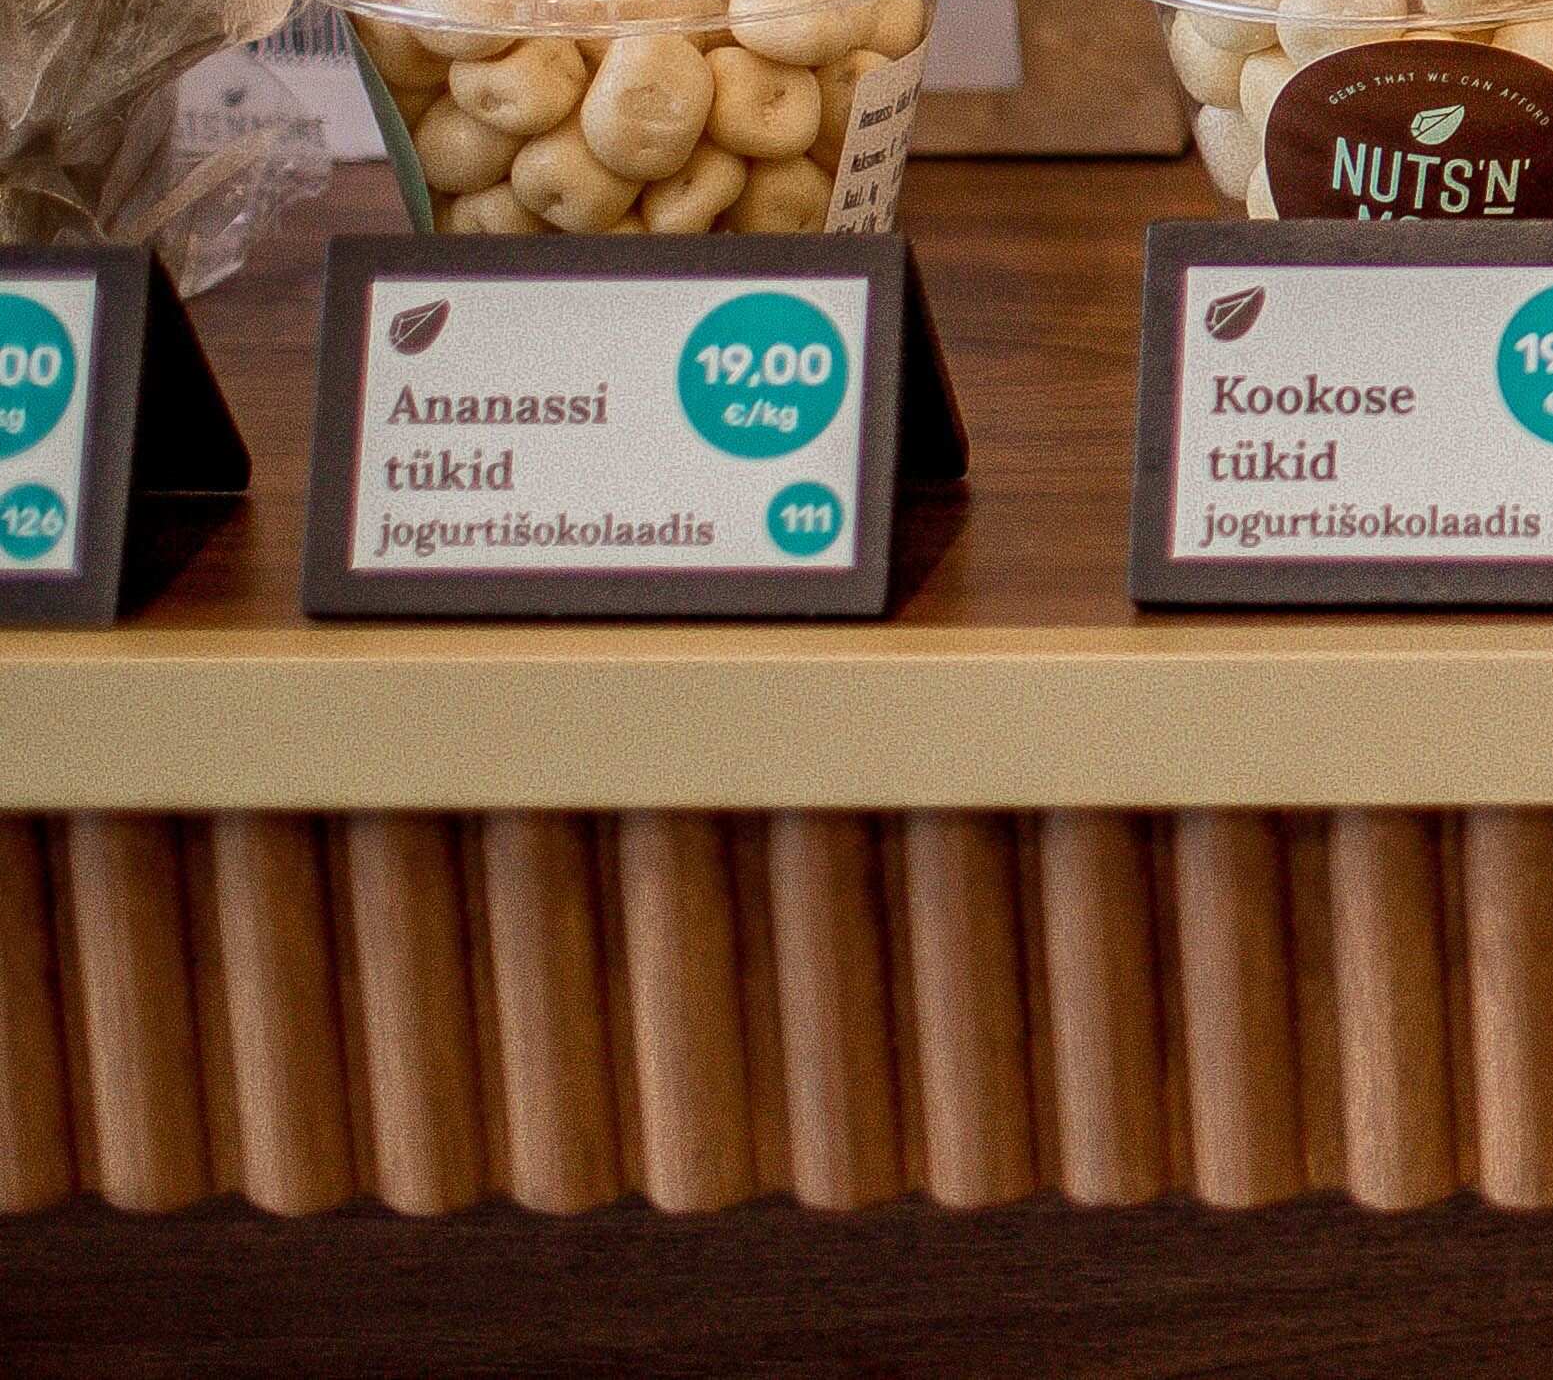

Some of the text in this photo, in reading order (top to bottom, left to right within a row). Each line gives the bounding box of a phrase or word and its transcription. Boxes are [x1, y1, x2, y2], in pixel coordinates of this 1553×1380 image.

[1373, 71, 1416, 86] THAT
[1428, 72, 1449, 83] WE
[1460, 75, 1494, 91] CAN
[1499, 88, 1550, 127] AFFORD
[1332, 136, 1531, 215] NUTS'N'
[695, 343, 832, 388] 19,00
[386, 382, 609, 426] Ananassi
[723, 400, 799, 433] €/kg
[1211, 373, 1416, 416] Kookose
[384, 449, 514, 493] tükid
[1208, 439, 1338, 483] tükid
[1, 506, 63, 538] 126
[374, 512, 716, 559] jogurtišokolaadis
[778, 503, 832, 535] 111
[1200, 502, 1542, 549] jogurtišokolaadis
